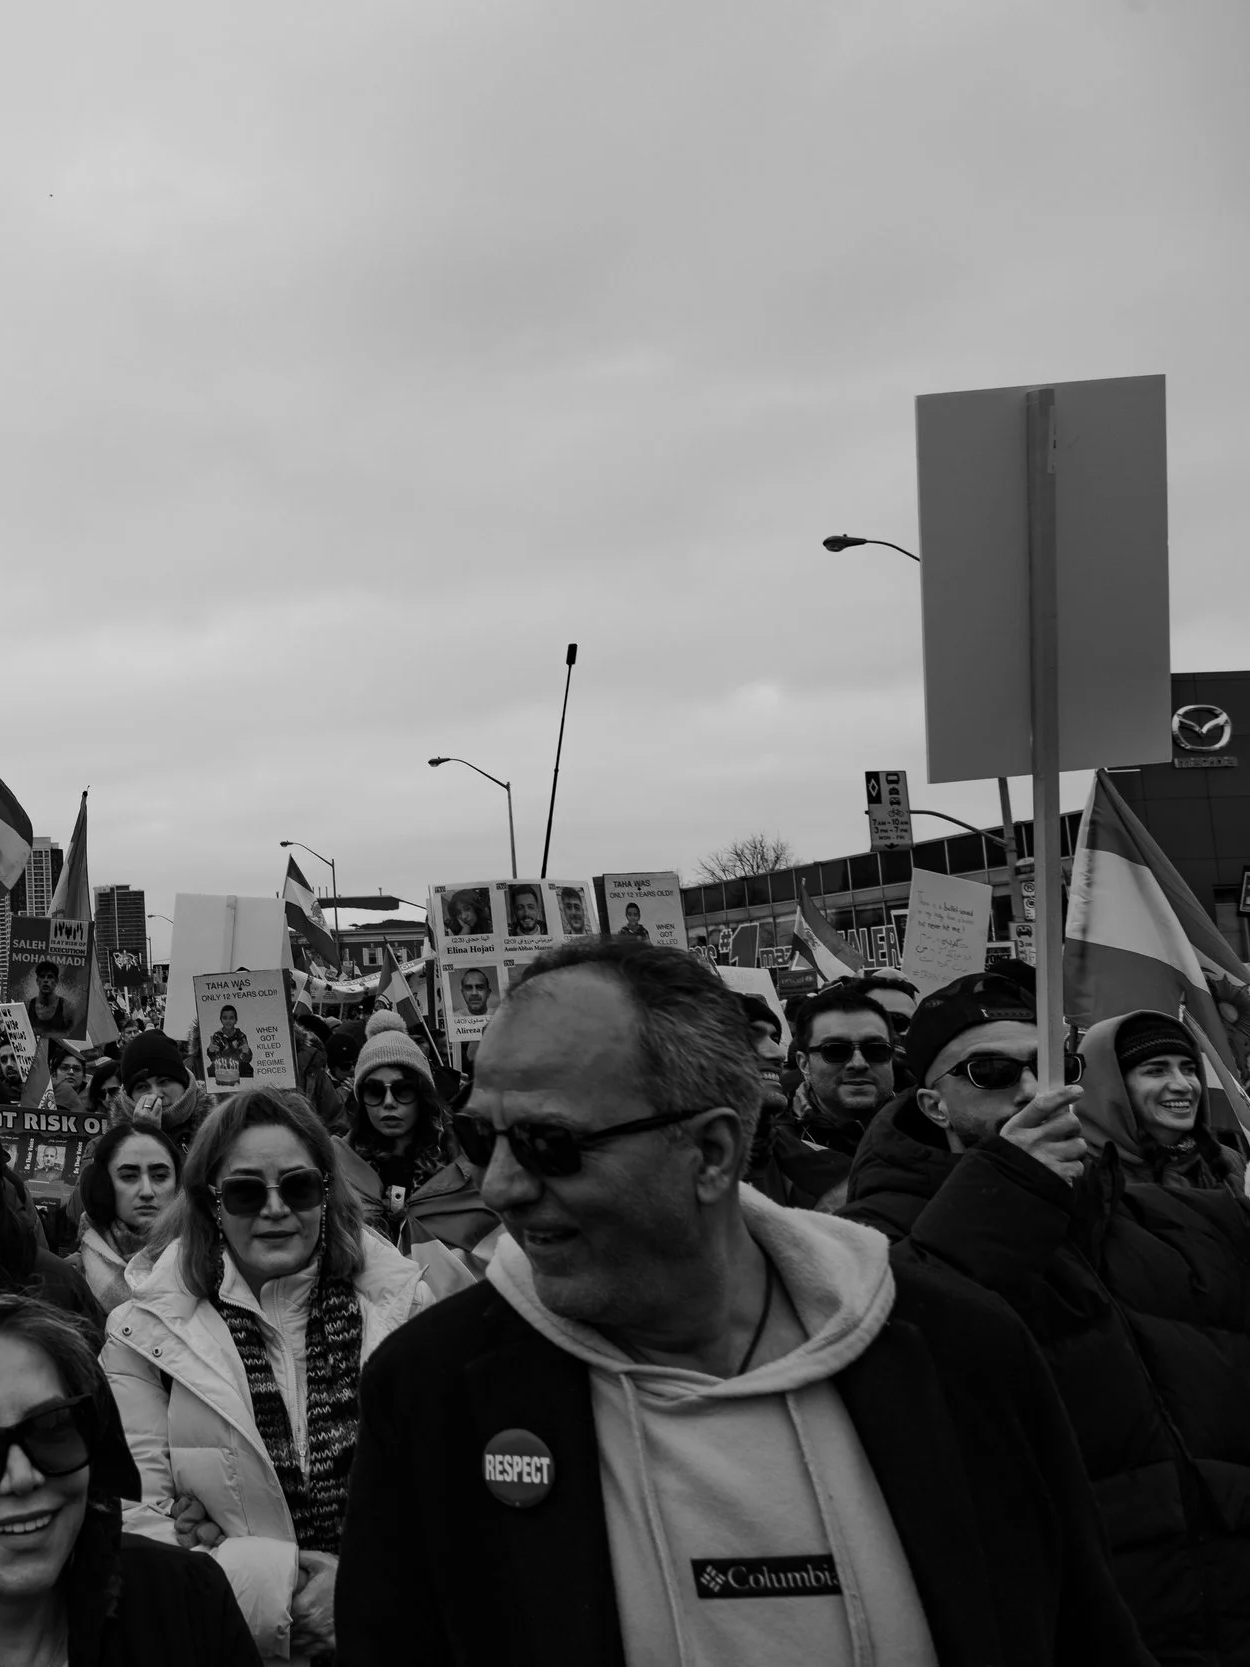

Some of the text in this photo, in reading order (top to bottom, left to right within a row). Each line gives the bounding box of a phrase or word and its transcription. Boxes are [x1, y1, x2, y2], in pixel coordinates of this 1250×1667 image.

[635, 890, 657, 898] YEARS
[12, 939, 46, 950] SALEH
[445, 943, 494, 956] Elina Hojati
[50, 947, 86, 956] EXECUTION
[11, 952, 86, 967] MOHAMMADI
[206, 978, 251, 991] TAHA WAS
[201, 993, 222, 1002] ONLY
[223, 992, 232, 1000] 12
[232, 990, 257, 999] YEARS
[256, 1026, 279, 1034] WHEN
[455, 1024, 482, 1035] Alireza
[256, 1042, 282, 1050] KILLED
[257, 1058, 286, 1067] REGIME
[257, 1066, 287, 1075] FORCES
[23, 1113, 79, 1134] RISK
[27, 1138, 35, 1151] Voice
[484, 1453, 551, 1485] RESPECT
